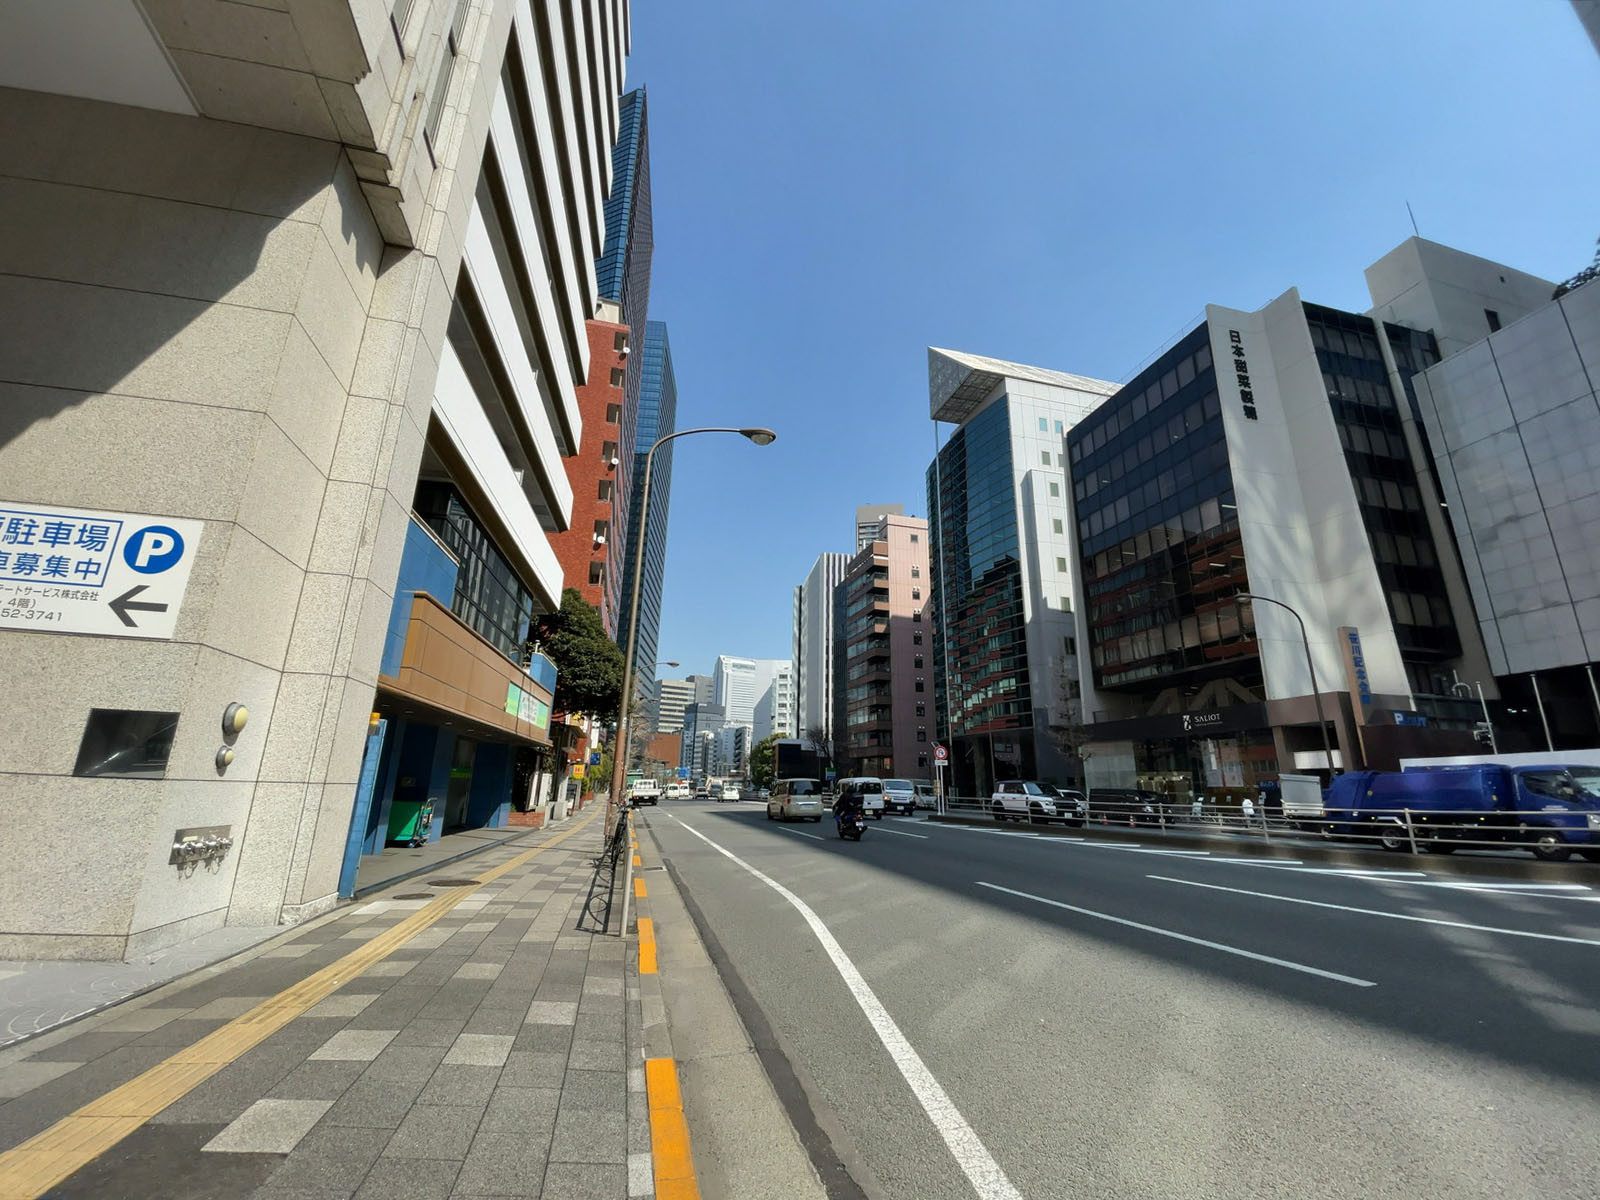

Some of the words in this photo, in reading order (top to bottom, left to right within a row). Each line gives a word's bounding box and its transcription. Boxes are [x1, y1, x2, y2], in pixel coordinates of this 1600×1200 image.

[0, 516, 110, 552] 駐車場
[135, 531, 175, 568] P
[1, 608, 63, 622] 52-3741
[1194, 713, 1221, 723] SALIOT
